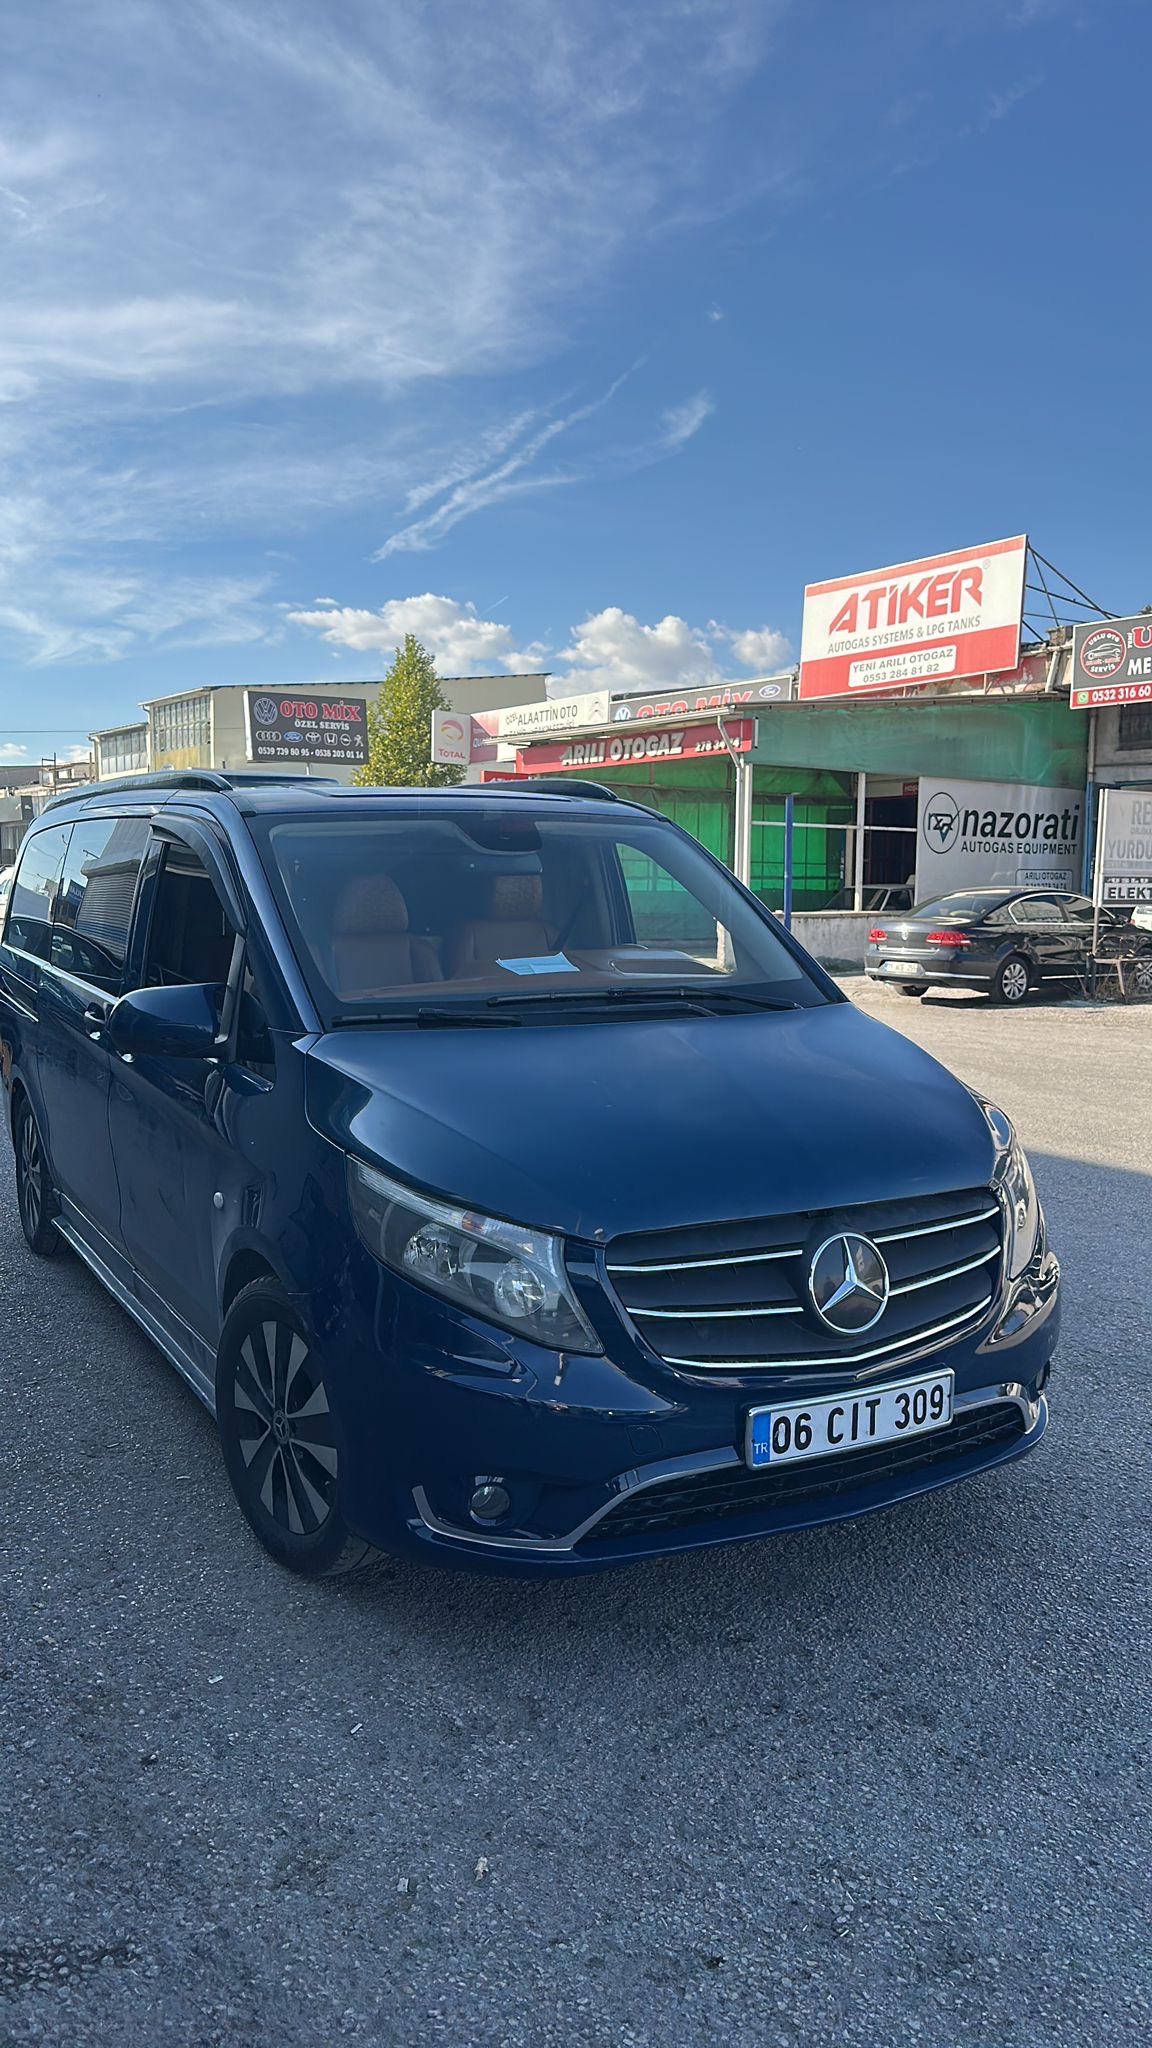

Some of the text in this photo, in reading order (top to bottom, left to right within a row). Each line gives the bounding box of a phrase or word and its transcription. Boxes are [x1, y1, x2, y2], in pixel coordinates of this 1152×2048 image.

[827, 615, 981, 654] AUTOGAS SYSTEMS & LPG TANKS
[853, 661, 876, 673] YENİ
[909, 648, 953, 664] OTOGAZ
[863, 663, 939, 683] 0553 284 81 82
[1092, 685, 1151, 702] 0532 316 60
[280, 700, 362, 721] OTO MİX
[560, 704, 578, 719] OTO
[294, 718, 350, 730] ÖZEL SERVİS
[438, 748, 466, 759] TOTAL
[560, 742, 606, 765] ARILI
[609, 732, 685, 761] OTOGAZ
[961, 805, 1079, 841] nazorati
[961, 841, 1078, 856] AUTOGAS EQUIPMENT
[1042, 872, 1067, 880] OTOGAZ
[772, 1384, 944, 1454] 06 CIT 309
[754, 1443, 768, 1454] TR
